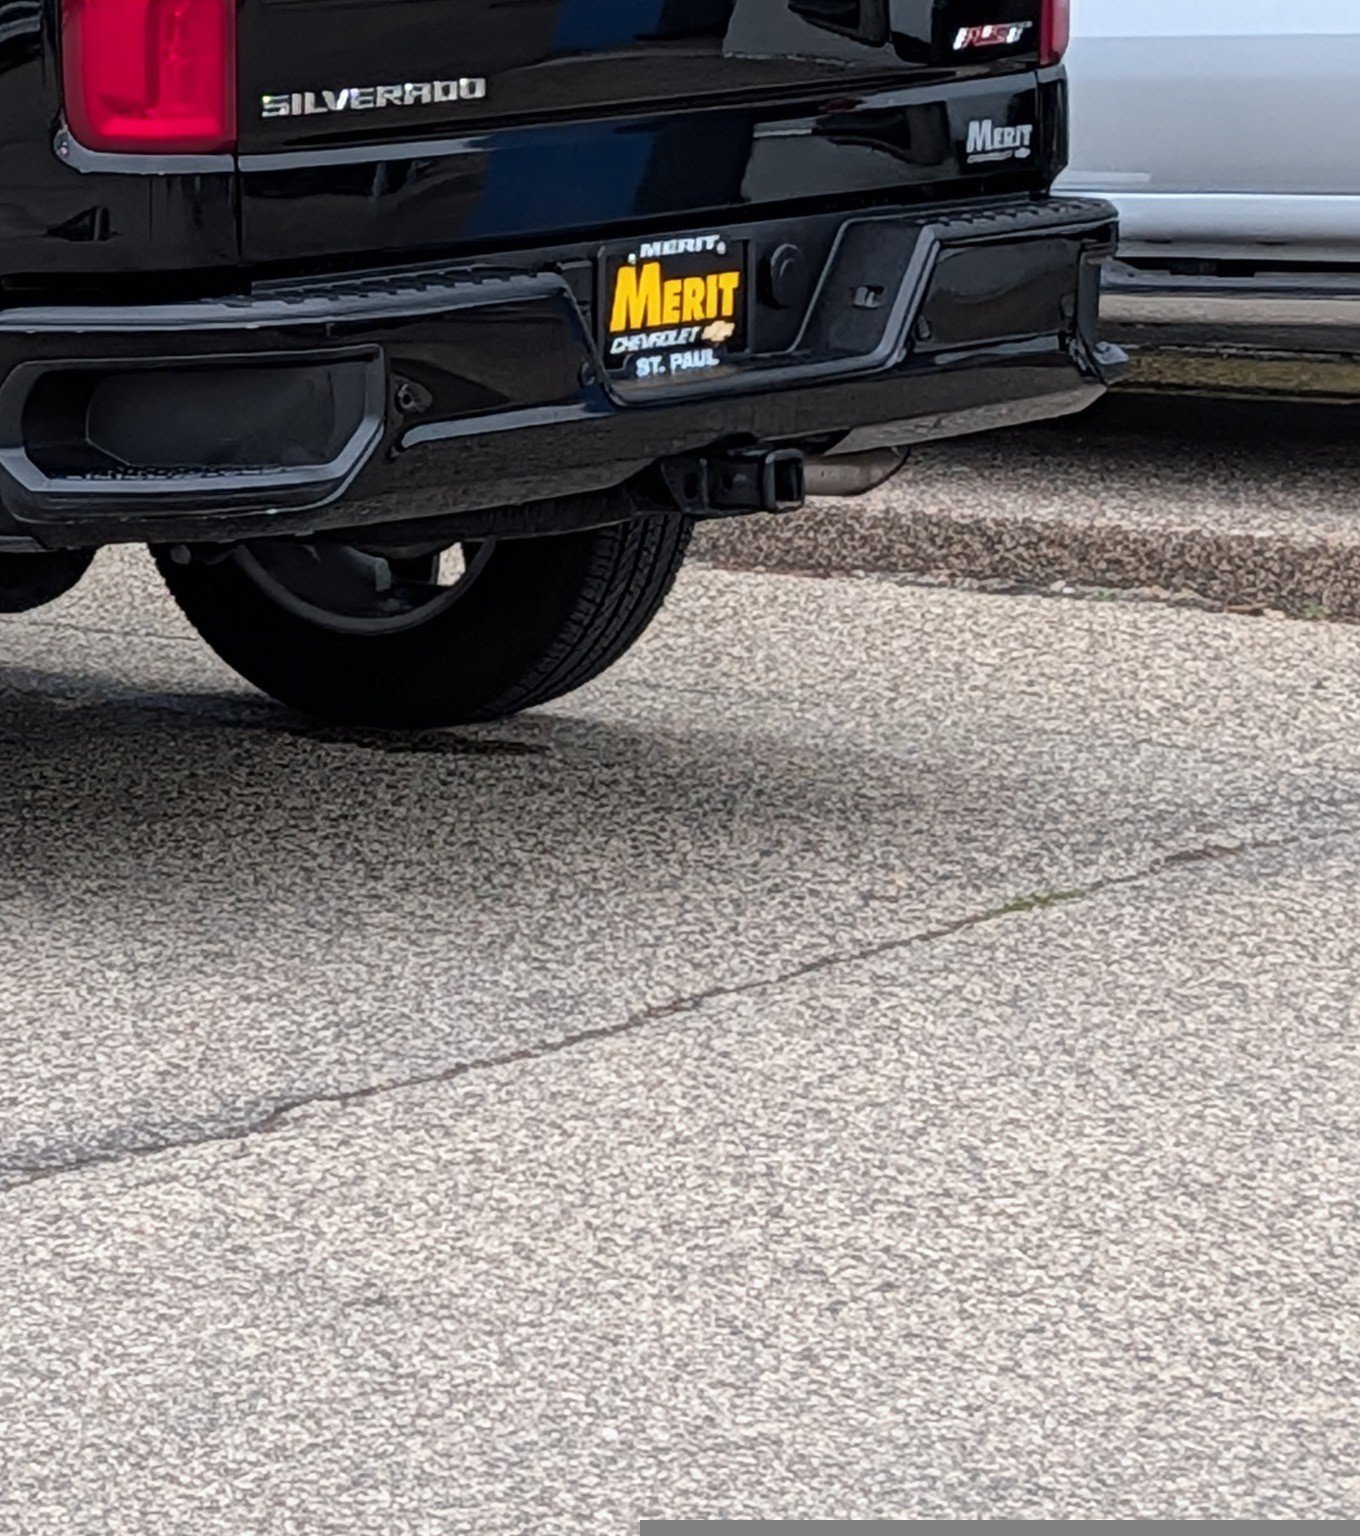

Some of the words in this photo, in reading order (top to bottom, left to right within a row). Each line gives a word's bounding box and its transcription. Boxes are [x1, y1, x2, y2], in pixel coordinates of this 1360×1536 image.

[262, 77, 486, 117] SILVERADO
[640, 234, 720, 258] MERIT
[610, 326, 701, 354] CHEVROLET
[636, 355, 666, 377] ST.
[669, 348, 720, 374] PAUL
